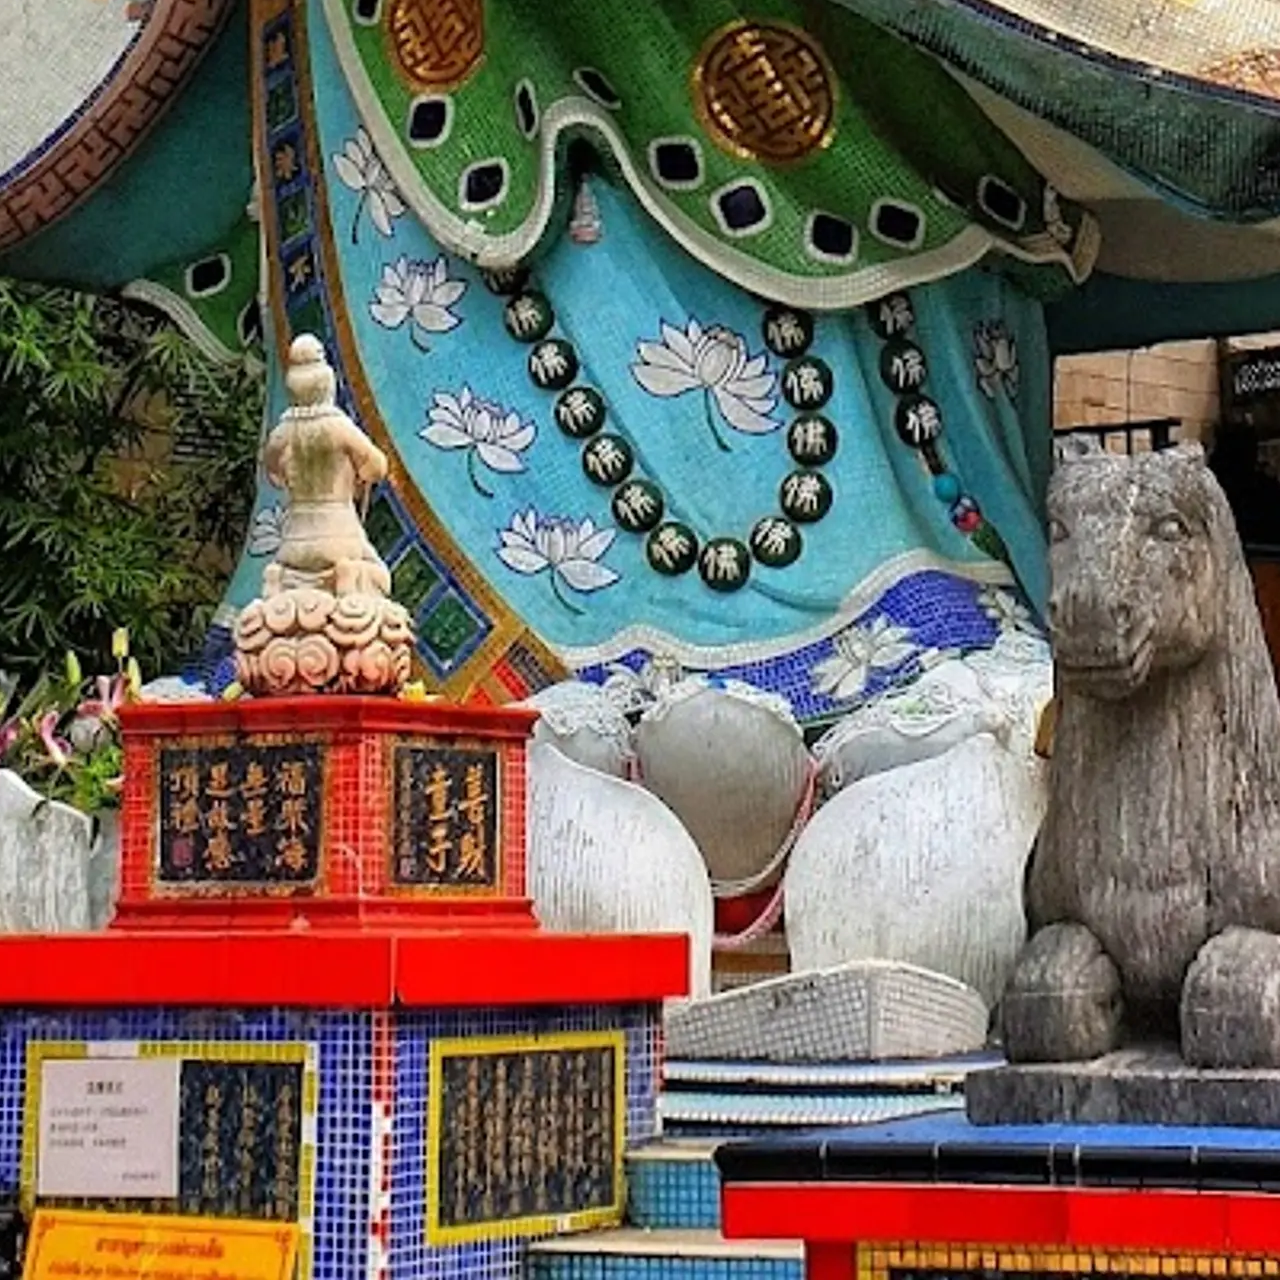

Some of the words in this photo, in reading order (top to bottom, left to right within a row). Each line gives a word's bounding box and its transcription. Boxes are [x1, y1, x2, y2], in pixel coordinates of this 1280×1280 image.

[768, 313, 804, 353] 佛
[531, 342, 568, 385] 佛
[786, 363, 824, 404] 佛
[892, 349, 926, 388] 佛
[559, 391, 596, 433] 佛
[906, 400, 942, 443] 佛
[792, 419, 827, 456] 佛
[586, 438, 626, 481] 佛
[616, 485, 657, 527] 佛
[784, 474, 821, 514] 佛
[651, 528, 690, 569] 佛
[755, 516, 794, 555] 佛
[704, 544, 740, 580] 佛
[424, 762, 453, 873] 童子
[458, 762, 488, 878] 善財
